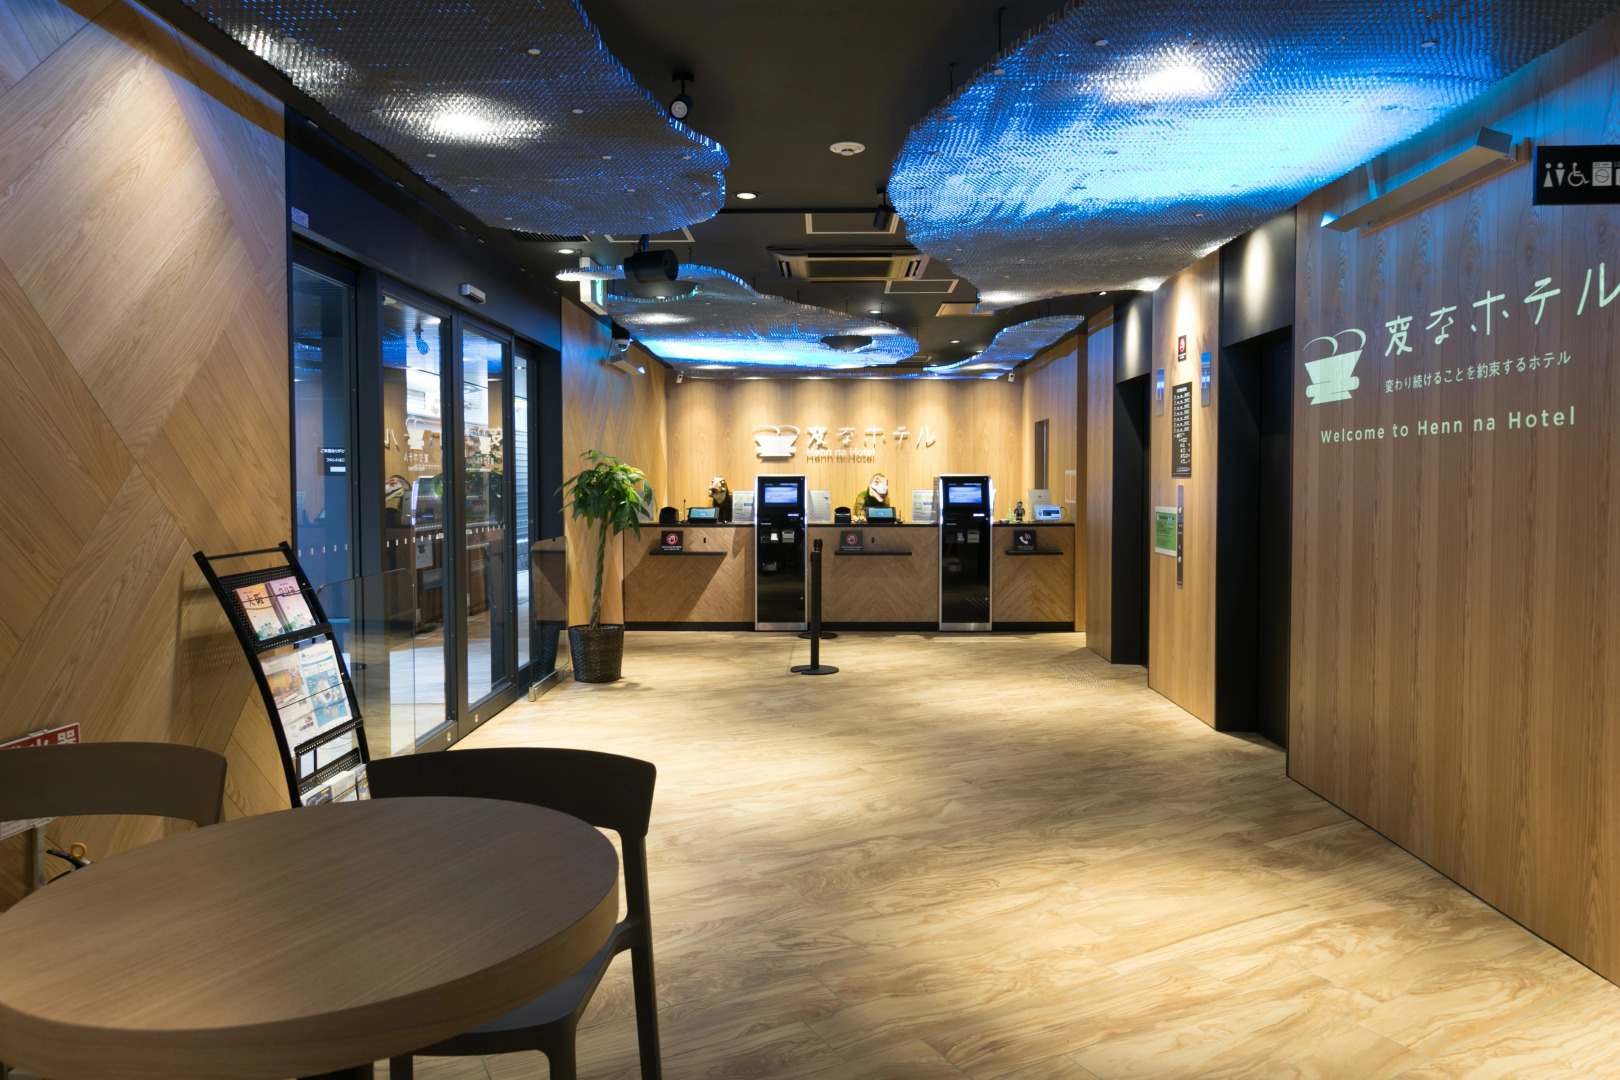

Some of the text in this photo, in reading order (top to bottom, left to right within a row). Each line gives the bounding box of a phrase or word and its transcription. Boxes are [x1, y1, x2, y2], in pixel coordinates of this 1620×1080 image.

[1384, 262, 1620, 356] 変なホテル
[1385, 350, 1572, 393] 変わり続けることを約束するホテル
[806, 425, 936, 446] 変なホテル
[1320, 406, 1576, 443] Welcome to Henn na Hotel
[806, 447, 832, 457] Henn
[849, 447, 875, 457] Hotel
